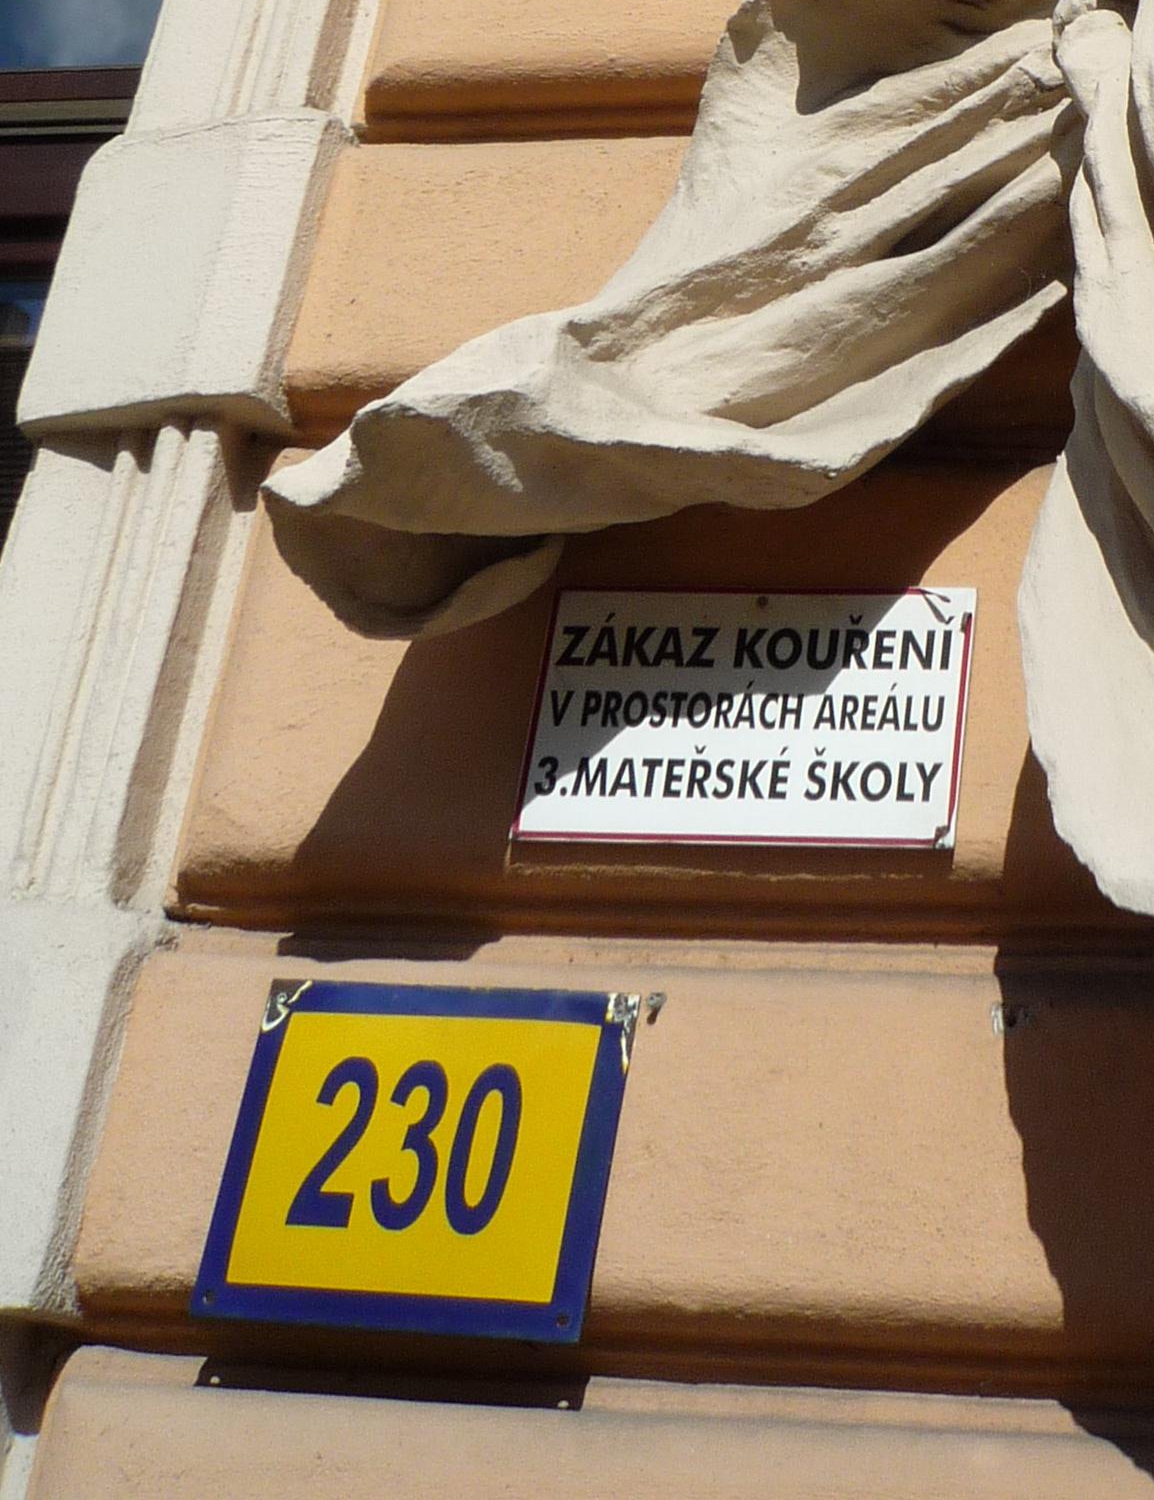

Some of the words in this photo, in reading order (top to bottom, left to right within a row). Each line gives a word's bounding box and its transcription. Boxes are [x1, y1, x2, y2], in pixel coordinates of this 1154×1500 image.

[555, 612, 721, 668] ZÁKAZ
[733, 615, 956, 671] KOUŘENÍ
[550, 690, 575, 728] V
[580, 682, 803, 731] PROSTORÁCH
[814, 683, 946, 733] AREÁLU
[803, 747, 944, 803] ŠKOLY
[285, 1056, 523, 1236] 230
